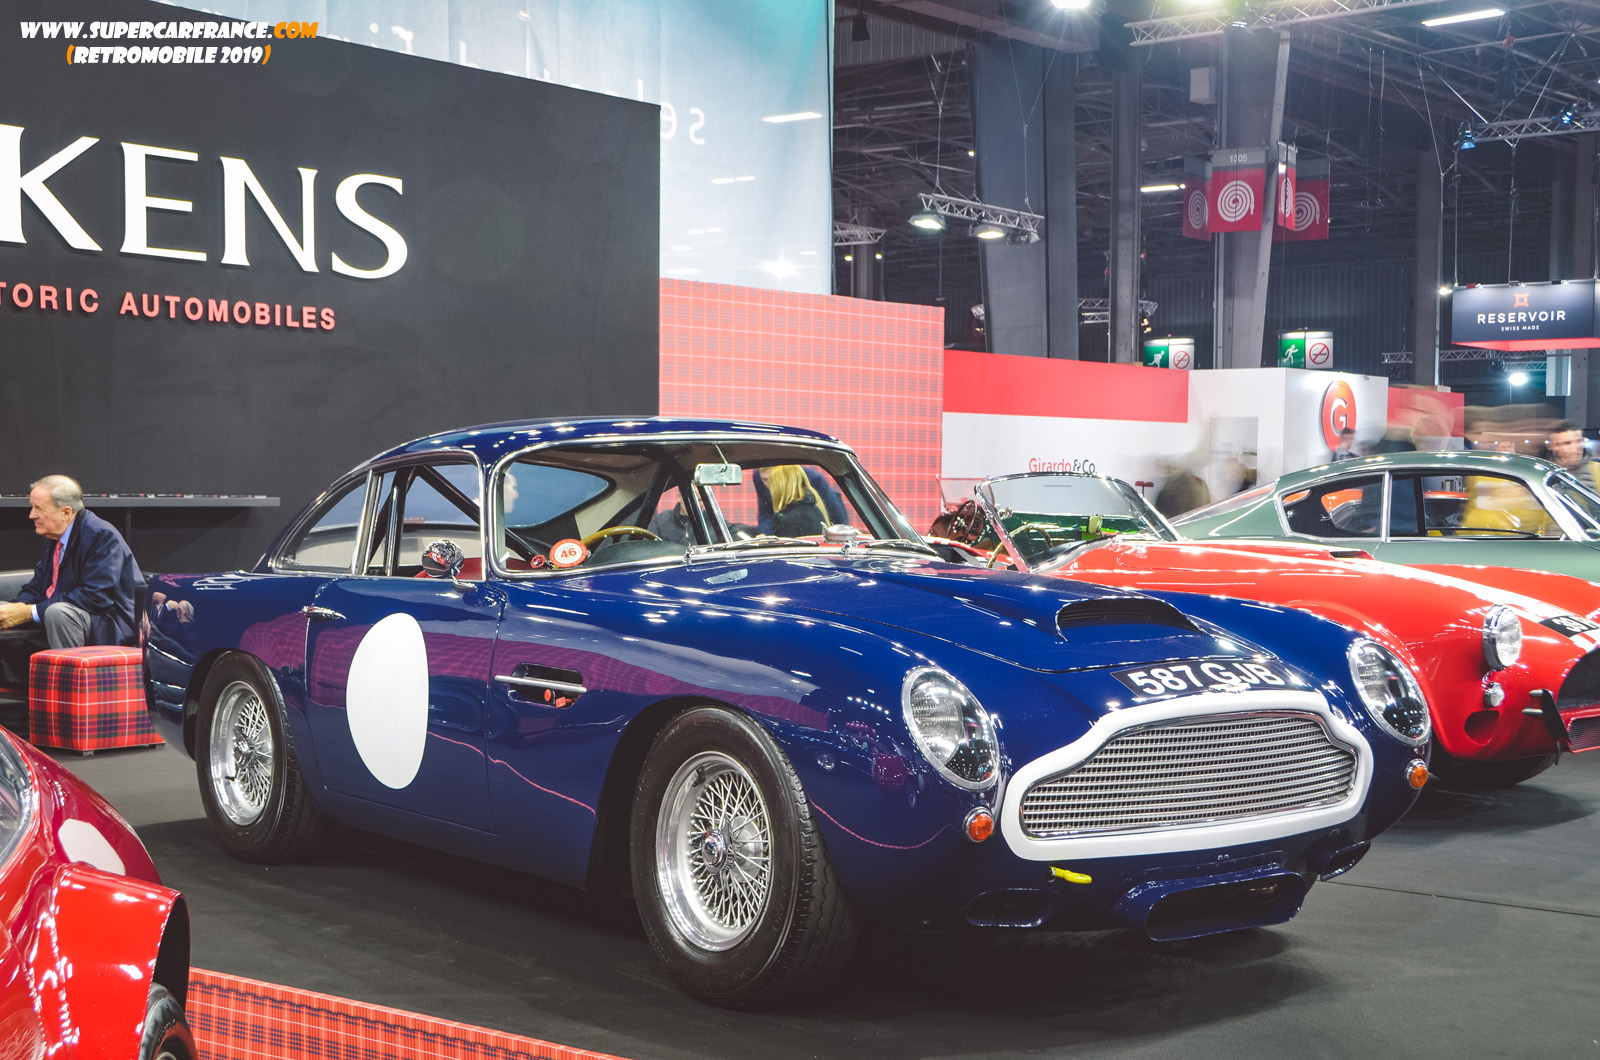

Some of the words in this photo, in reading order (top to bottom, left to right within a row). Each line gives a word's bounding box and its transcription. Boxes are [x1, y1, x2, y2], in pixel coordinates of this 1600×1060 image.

[1229, 153, 1248, 163] 1305
[0, 123, 408, 279] KENS
[120, 292, 335, 330] AUTOMOBILES
[1477, 310, 1566, 324] RESERVOIR
[1331, 397, 1347, 436] G
[560, 547, 577, 558] 46
[1128, 664, 1203, 696] 587
[1200, 662, 1286, 686] GJB
